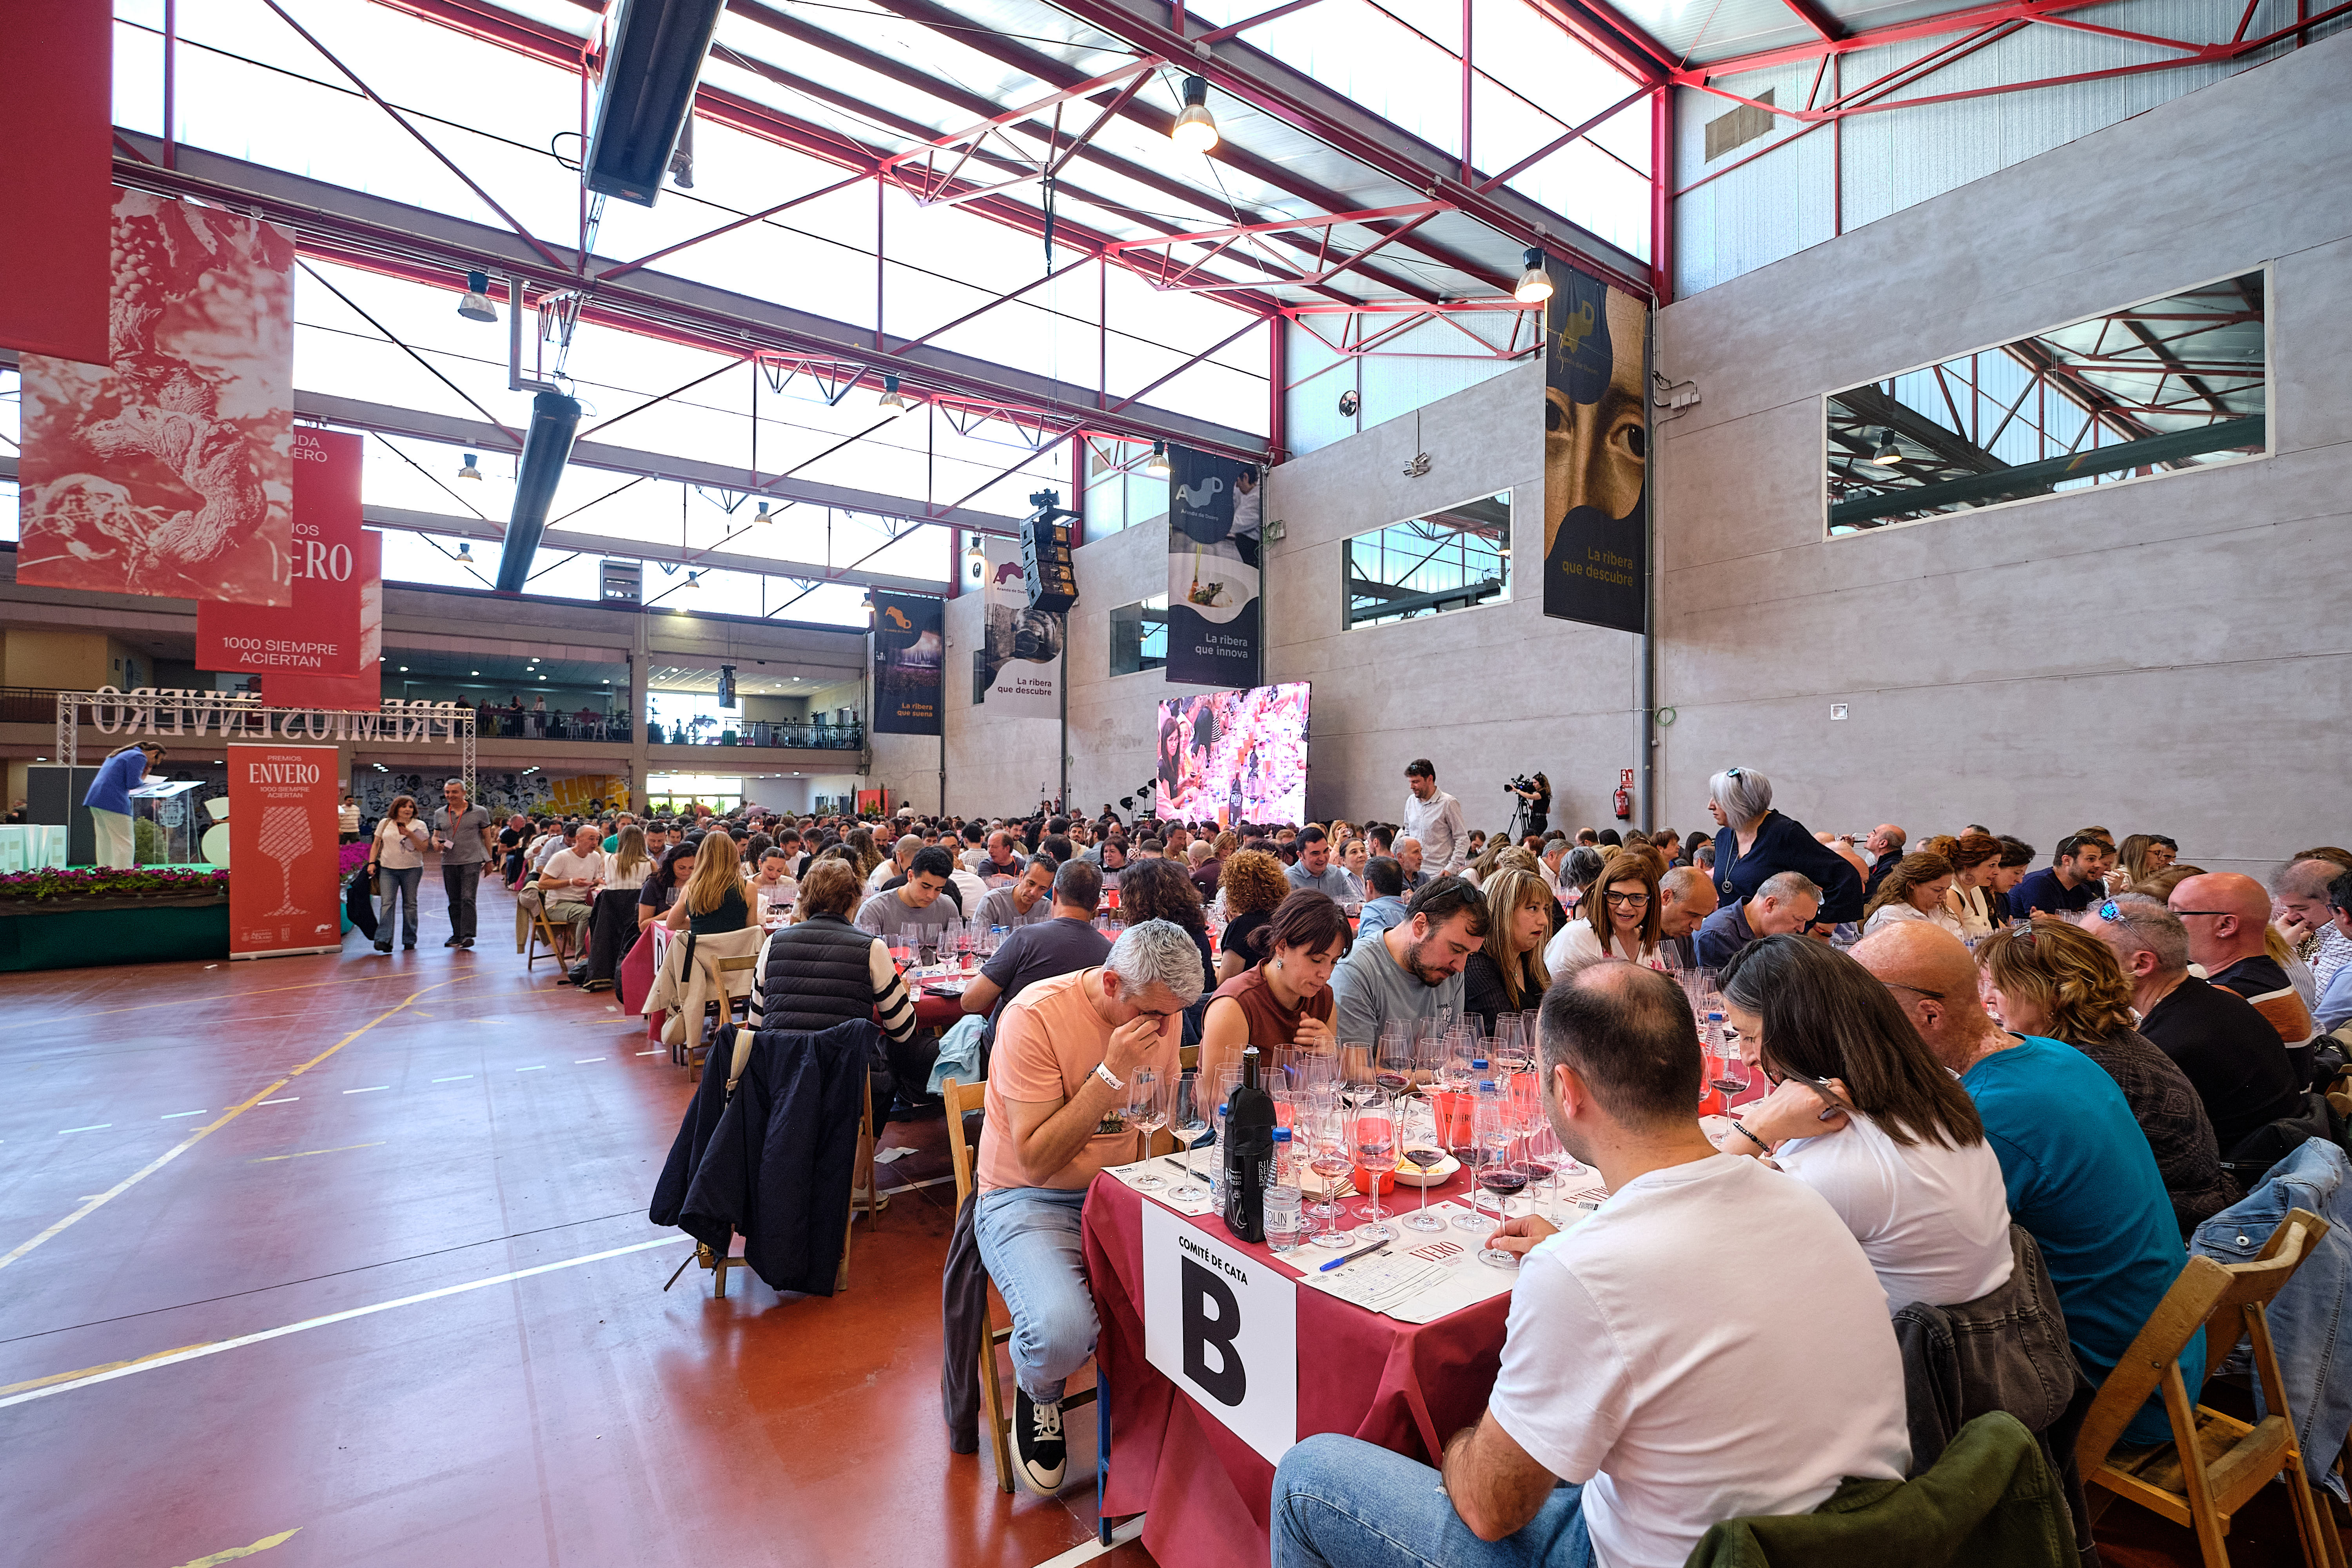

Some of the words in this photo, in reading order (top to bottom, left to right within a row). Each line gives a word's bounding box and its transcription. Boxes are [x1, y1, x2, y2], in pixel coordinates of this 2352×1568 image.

[1588, 546, 1600, 561] La
[1603, 551, 1633, 569] ribera
[1563, 561, 1583, 575] que
[1586, 564, 1633, 586] descubre
[223, 637, 261, 650] 1000
[265, 639, 338, 655] SIEMPRE
[1206, 633, 1217, 643] La
[1220, 635, 1248, 646] ribera
[240, 652, 321, 667] ACIERTAN
[1196, 646, 1214, 655] que
[1217, 646, 1248, 659] innova
[1016, 687, 1051, 695] descubre
[1029, 679, 1051, 687] ribera
[249, 764, 320, 783] ENVERO
[1179, 1236, 1209, 1262] COMITÉ
[1212, 1254, 1222, 1270] DE
[1225, 1263, 1248, 1285] CATA
[1408, 1241, 1464, 1262] VERO
[1181, 1254, 1246, 1406] B
